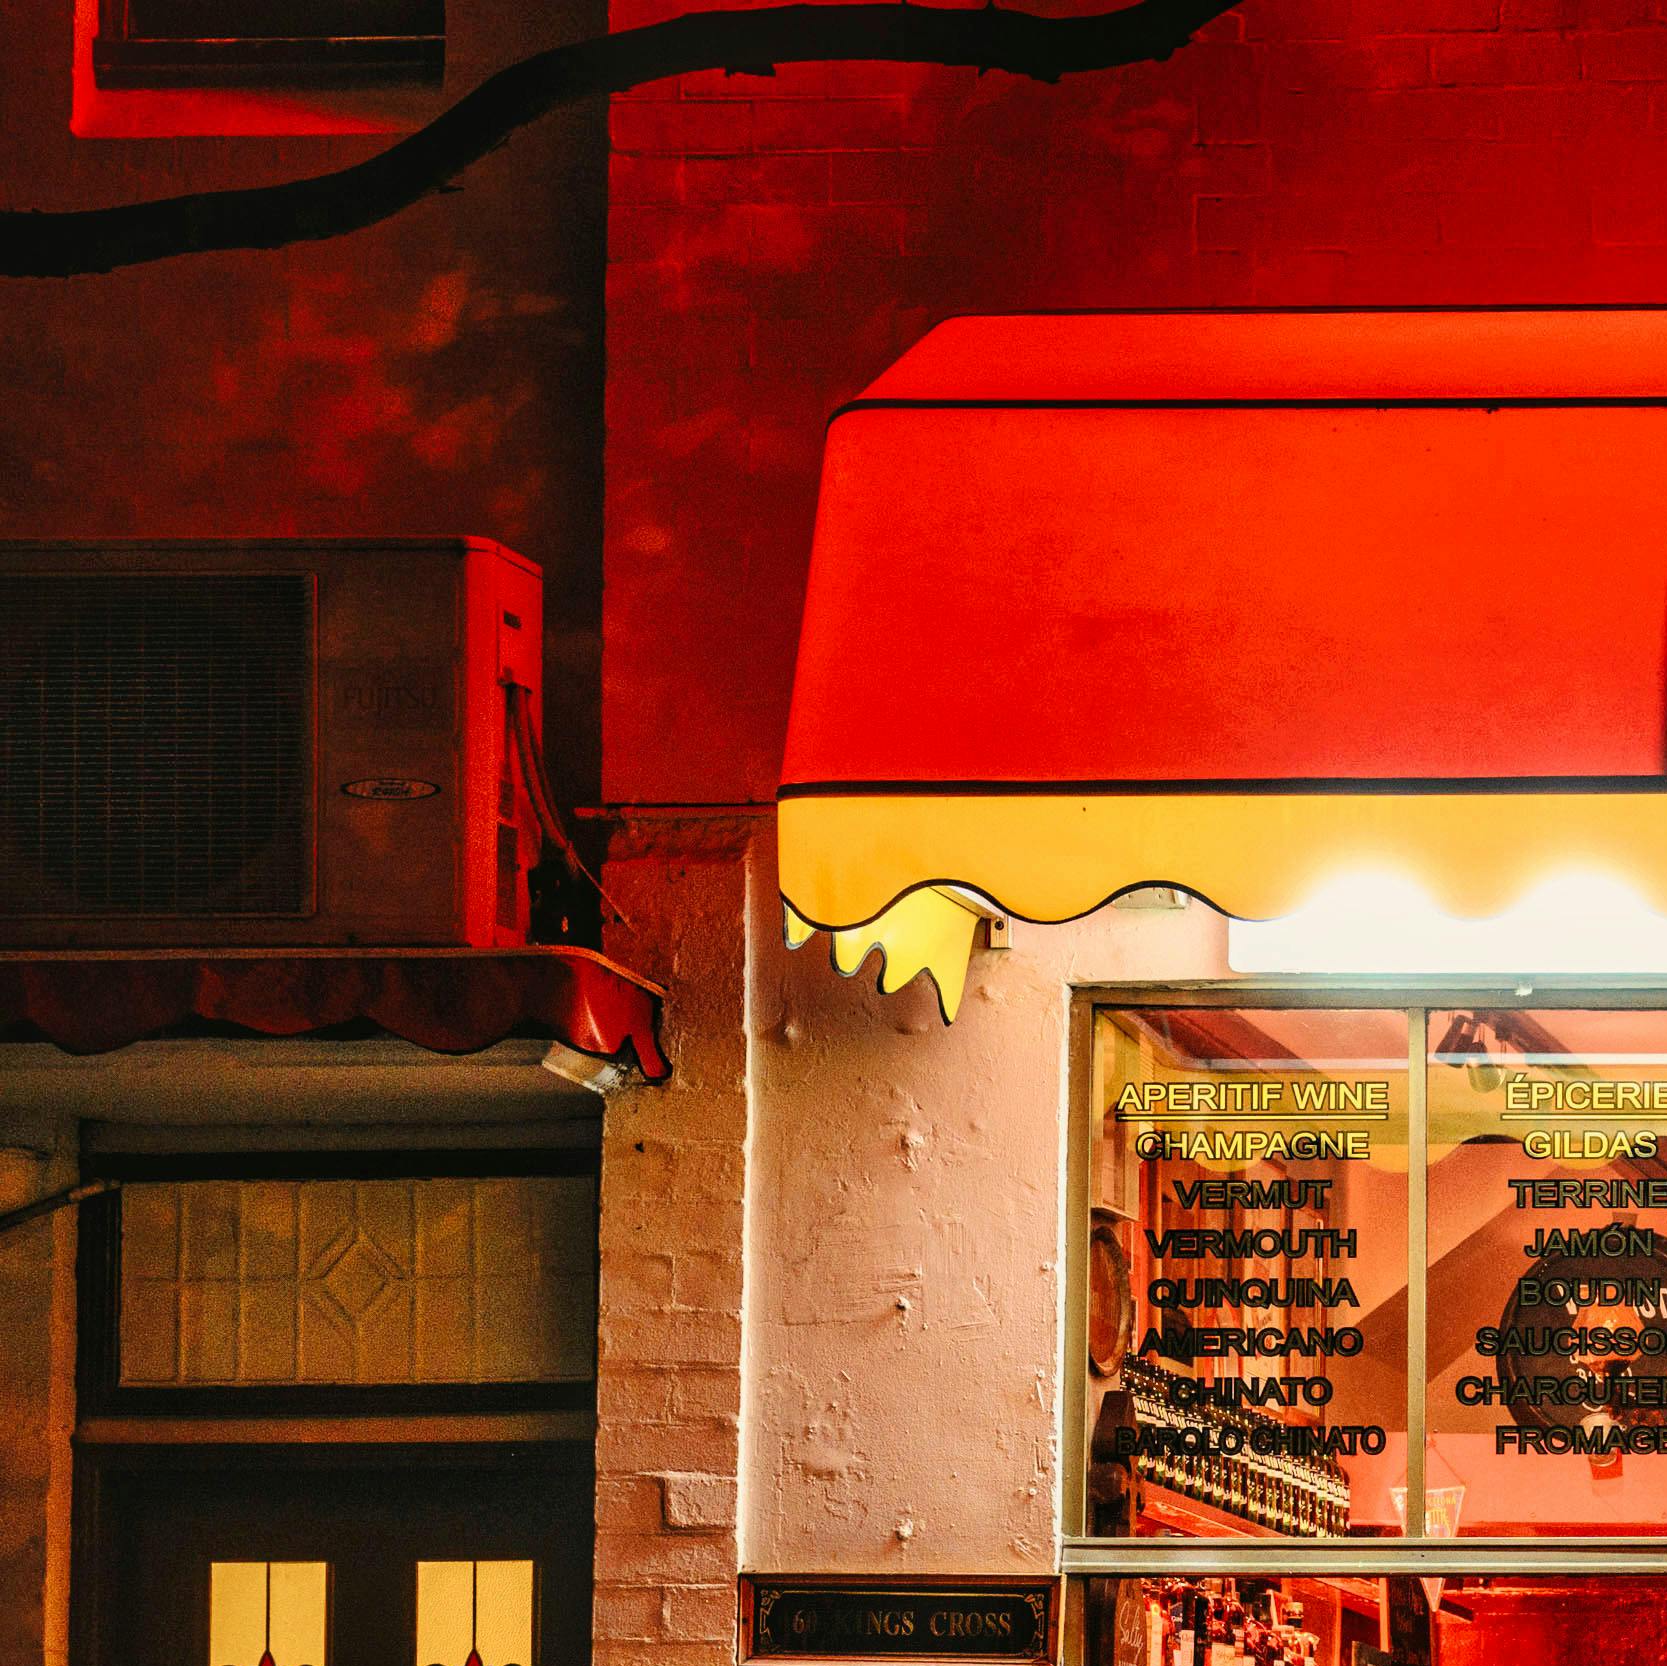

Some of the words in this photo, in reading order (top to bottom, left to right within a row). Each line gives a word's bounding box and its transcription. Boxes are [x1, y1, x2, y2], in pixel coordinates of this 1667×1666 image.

[1116, 1082, 1282, 1111] APERITIF
[1292, 1082, 1389, 1111] WINE
[1136, 1131, 1370, 1160] CHAMPAGNE
[1523, 1130, 1658, 1160] GILDAS
[1174, 1180, 1332, 1209] VERMUT
[1144, 1229, 1356, 1259] VERMOUTH
[1524, 1222, 1654, 1258] JAMÓN
[1147, 1278, 1360, 1309] QUINQUINA
[1517, 1278, 1661, 1307] BOUDIN
[1138, 1326, 1364, 1357] AMERICANO
[1170, 1376, 1333, 1406] CHINATO
[1116, 1426, 1244, 1456] BAROLO
[1250, 1426, 1387, 1456] CHINATO
[930, 1611, 1012, 1638] CROSS
